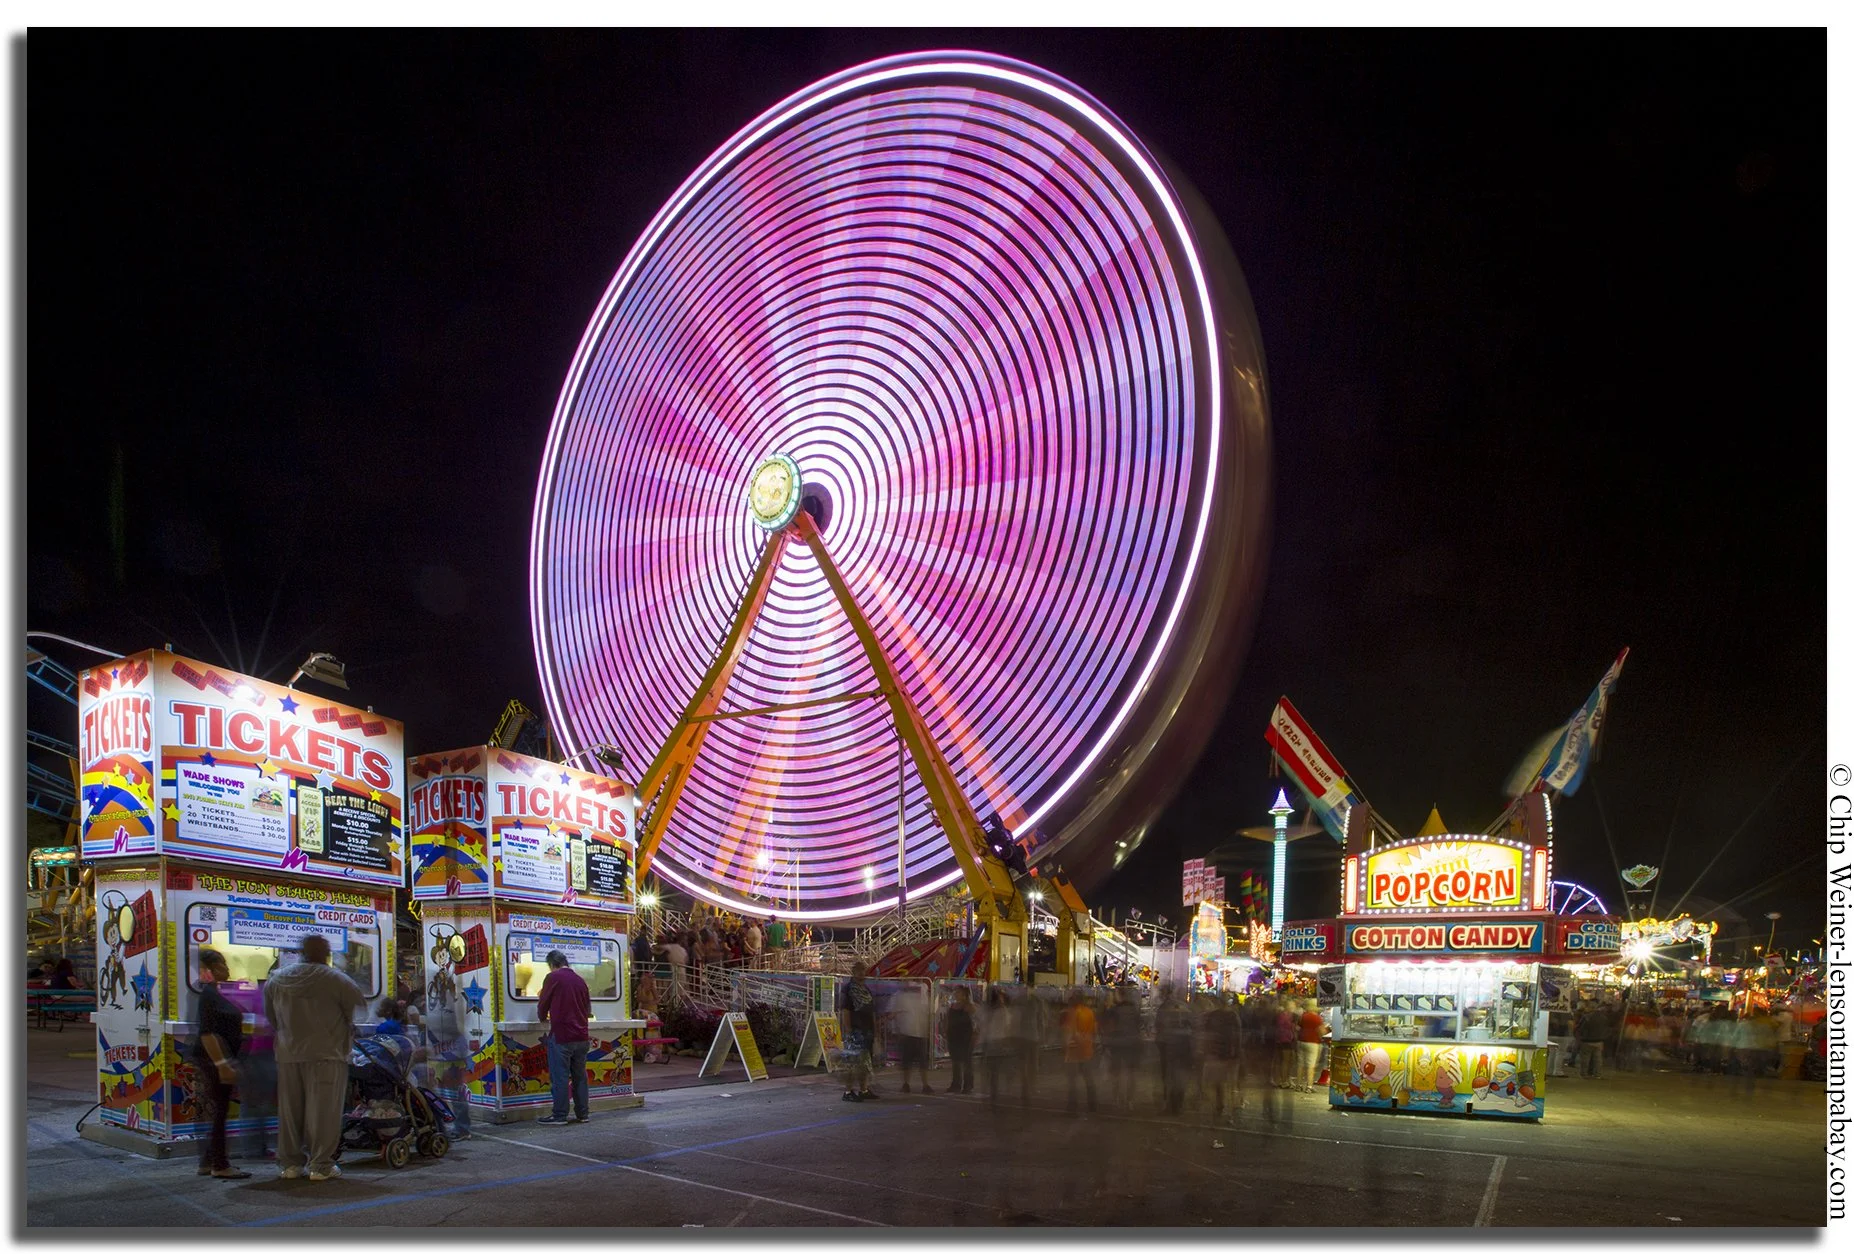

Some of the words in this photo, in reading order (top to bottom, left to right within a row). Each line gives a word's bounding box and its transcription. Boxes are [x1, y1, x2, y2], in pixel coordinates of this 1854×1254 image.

[85, 697, 151, 763] TICKETS
[172, 703, 391, 790] TICKETS
[183, 769, 210, 781] WADE
[212, 776, 245, 789] SHOWS
[324, 795, 347, 807] BEAT
[349, 796, 365, 809] THE
[413, 779, 485, 829] TICKETS
[498, 784, 627, 839] TICKETS
[187, 819, 239, 832] WRISTBANDS
[346, 819, 369, 829] $10.00
[347, 836, 368, 845] $15.00
[197, 874, 233, 891] THE
[235, 880, 273, 896] FUN
[276, 885, 327, 902] STARTS
[330, 891, 371, 907] HERE!
[1374, 868, 1517, 903] POPCORN
[227, 895, 284, 907] Remember
[286, 901, 312, 910] Your
[264, 912, 295, 922] Discover
[317, 910, 347, 921] CREDIT
[348, 913, 374, 925] CARDS
[234, 920, 271, 929] PURCHASE
[272, 923, 290, 931] RIDE
[292, 924, 323, 934] COUPONS
[512, 920, 532, 929] CREDIT
[534, 921, 551, 931] CARDS
[1285, 936, 1327, 951] RINKS
[1353, 926, 1444, 949] COTTON
[1449, 925, 1538, 949] CANDY
[511, 952, 519, 962] N
[105, 1046, 136, 1065] TICKETS
